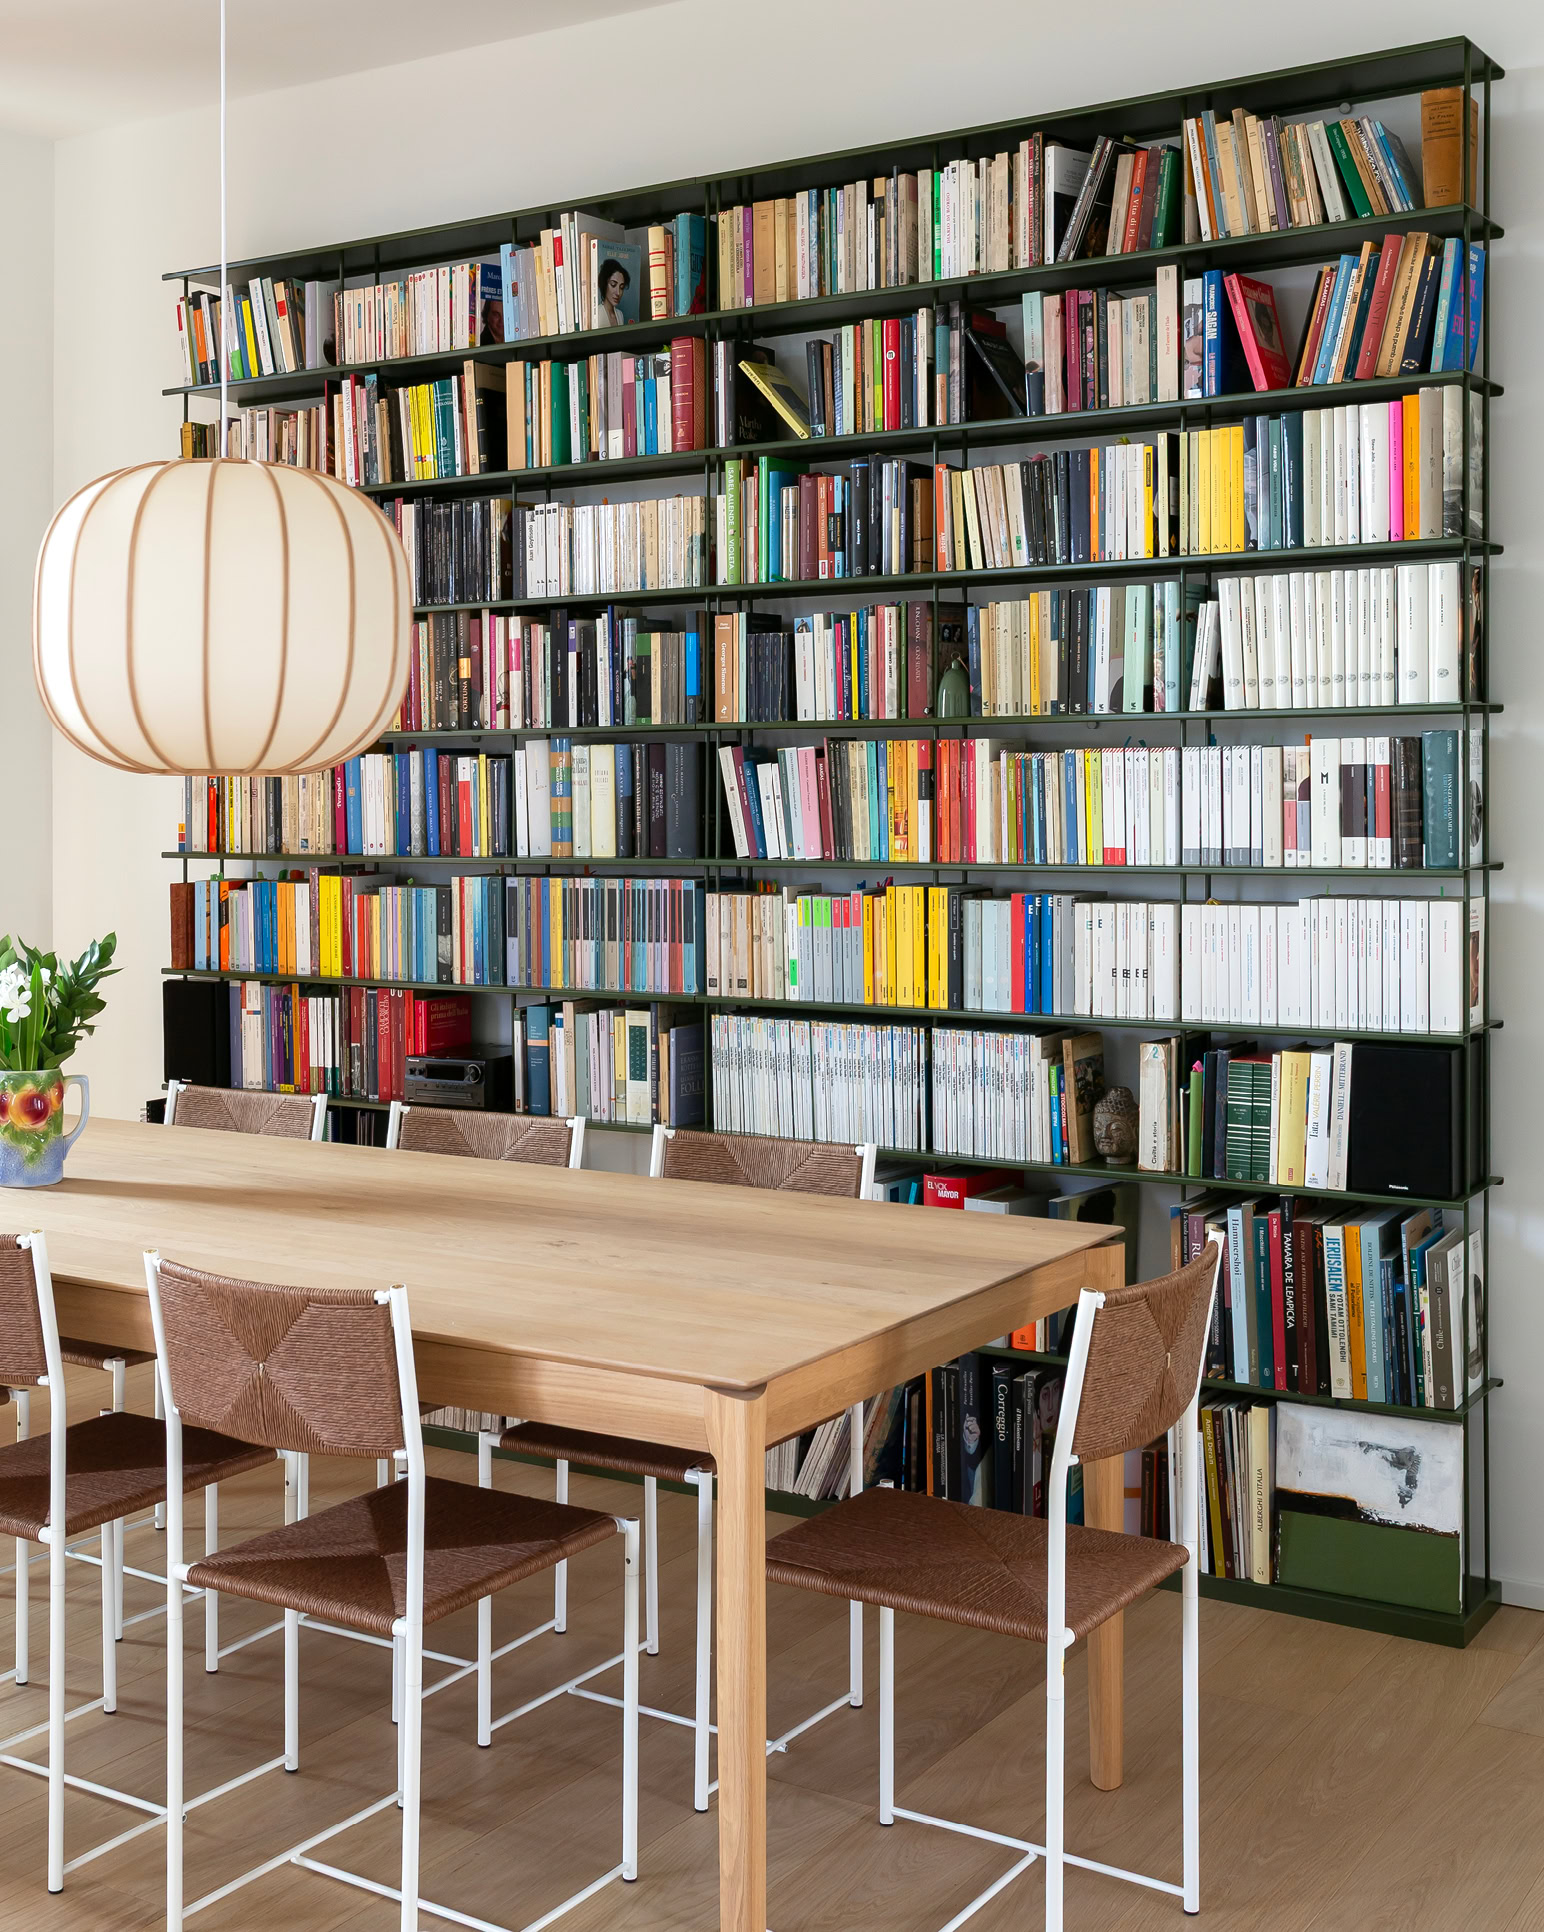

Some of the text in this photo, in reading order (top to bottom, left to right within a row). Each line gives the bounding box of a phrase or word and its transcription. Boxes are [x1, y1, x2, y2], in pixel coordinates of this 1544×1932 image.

[1129, 199, 1139, 237] Vita di Pi
[1320, 276, 1331, 307] VILA-MATAS
[1371, 290, 1387, 328] DANTE
[1207, 312, 1217, 340] SAGAN
[1152, 1046, 1159, 1059] 2
[1339, 1050, 1347, 1090] MITTERRAND
[1308, 1065, 1321, 1139] Tata VALÉRIE PERRIN
[934, 1182, 948, 1191] VOX
[937, 1189, 959, 1199] MAYOR
[1283, 1232, 1295, 1328] TAMARA DE LEMPICKA
[1325, 1237, 1343, 1292] JERUSALEM
[1329, 1293, 1338, 1338] SAMI TAMIMI
[1336, 1293, 1346, 1363] YOTAM OTTOLENGHI
[1435, 1329, 1445, 1350] Chile
[996, 1384, 1009, 1441] Correggio
